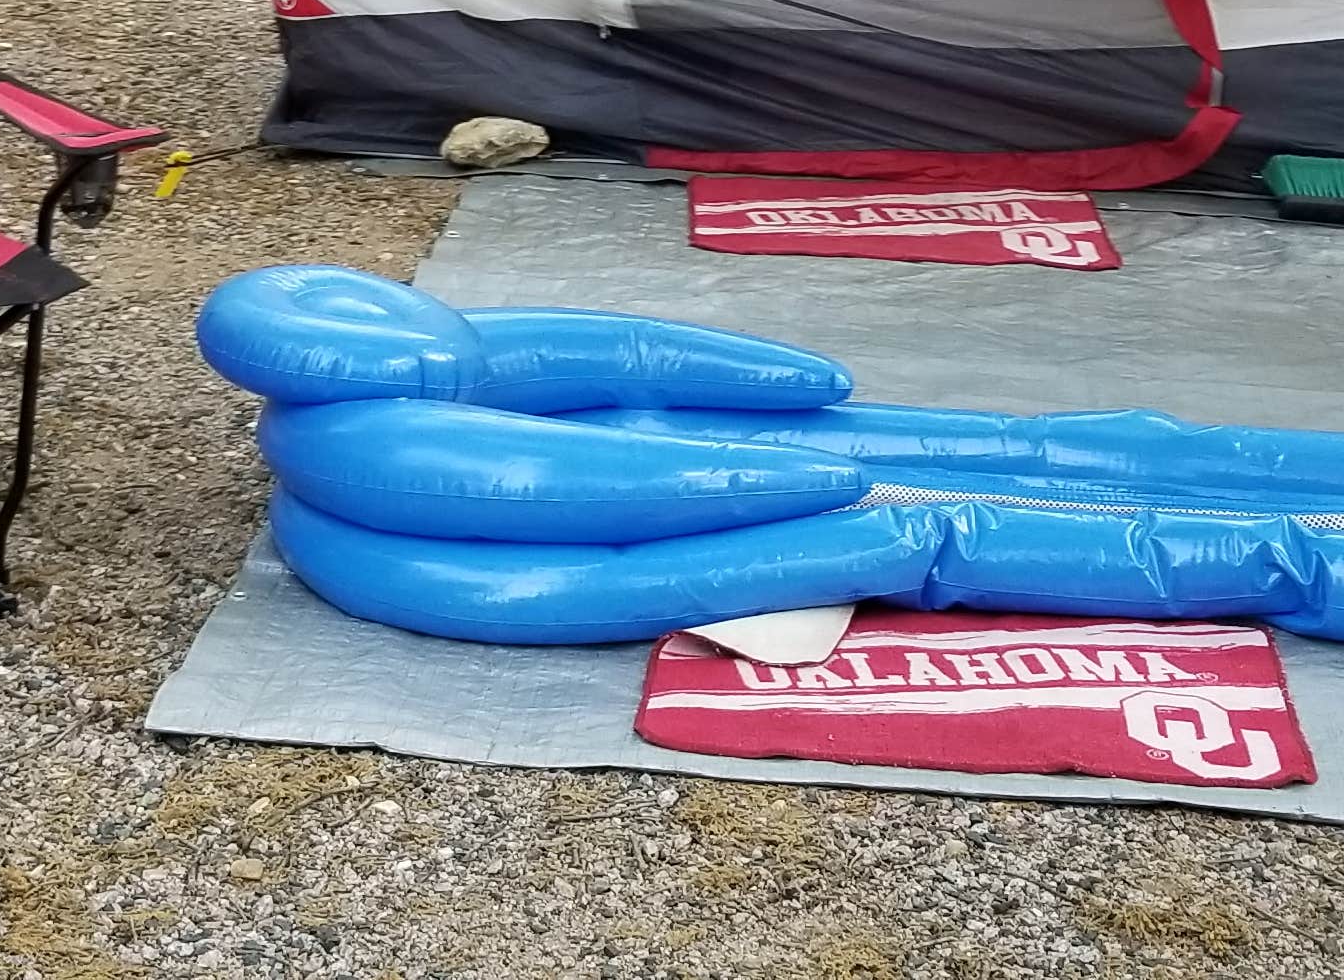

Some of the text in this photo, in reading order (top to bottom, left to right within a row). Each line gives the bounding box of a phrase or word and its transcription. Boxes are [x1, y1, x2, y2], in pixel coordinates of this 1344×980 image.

[745, 201, 1042, 227] OKLAHOMA
[1000, 226, 1099, 266] OU
[735, 646, 1199, 690] OKLAHOMA
[1120, 690, 1281, 781] OU
